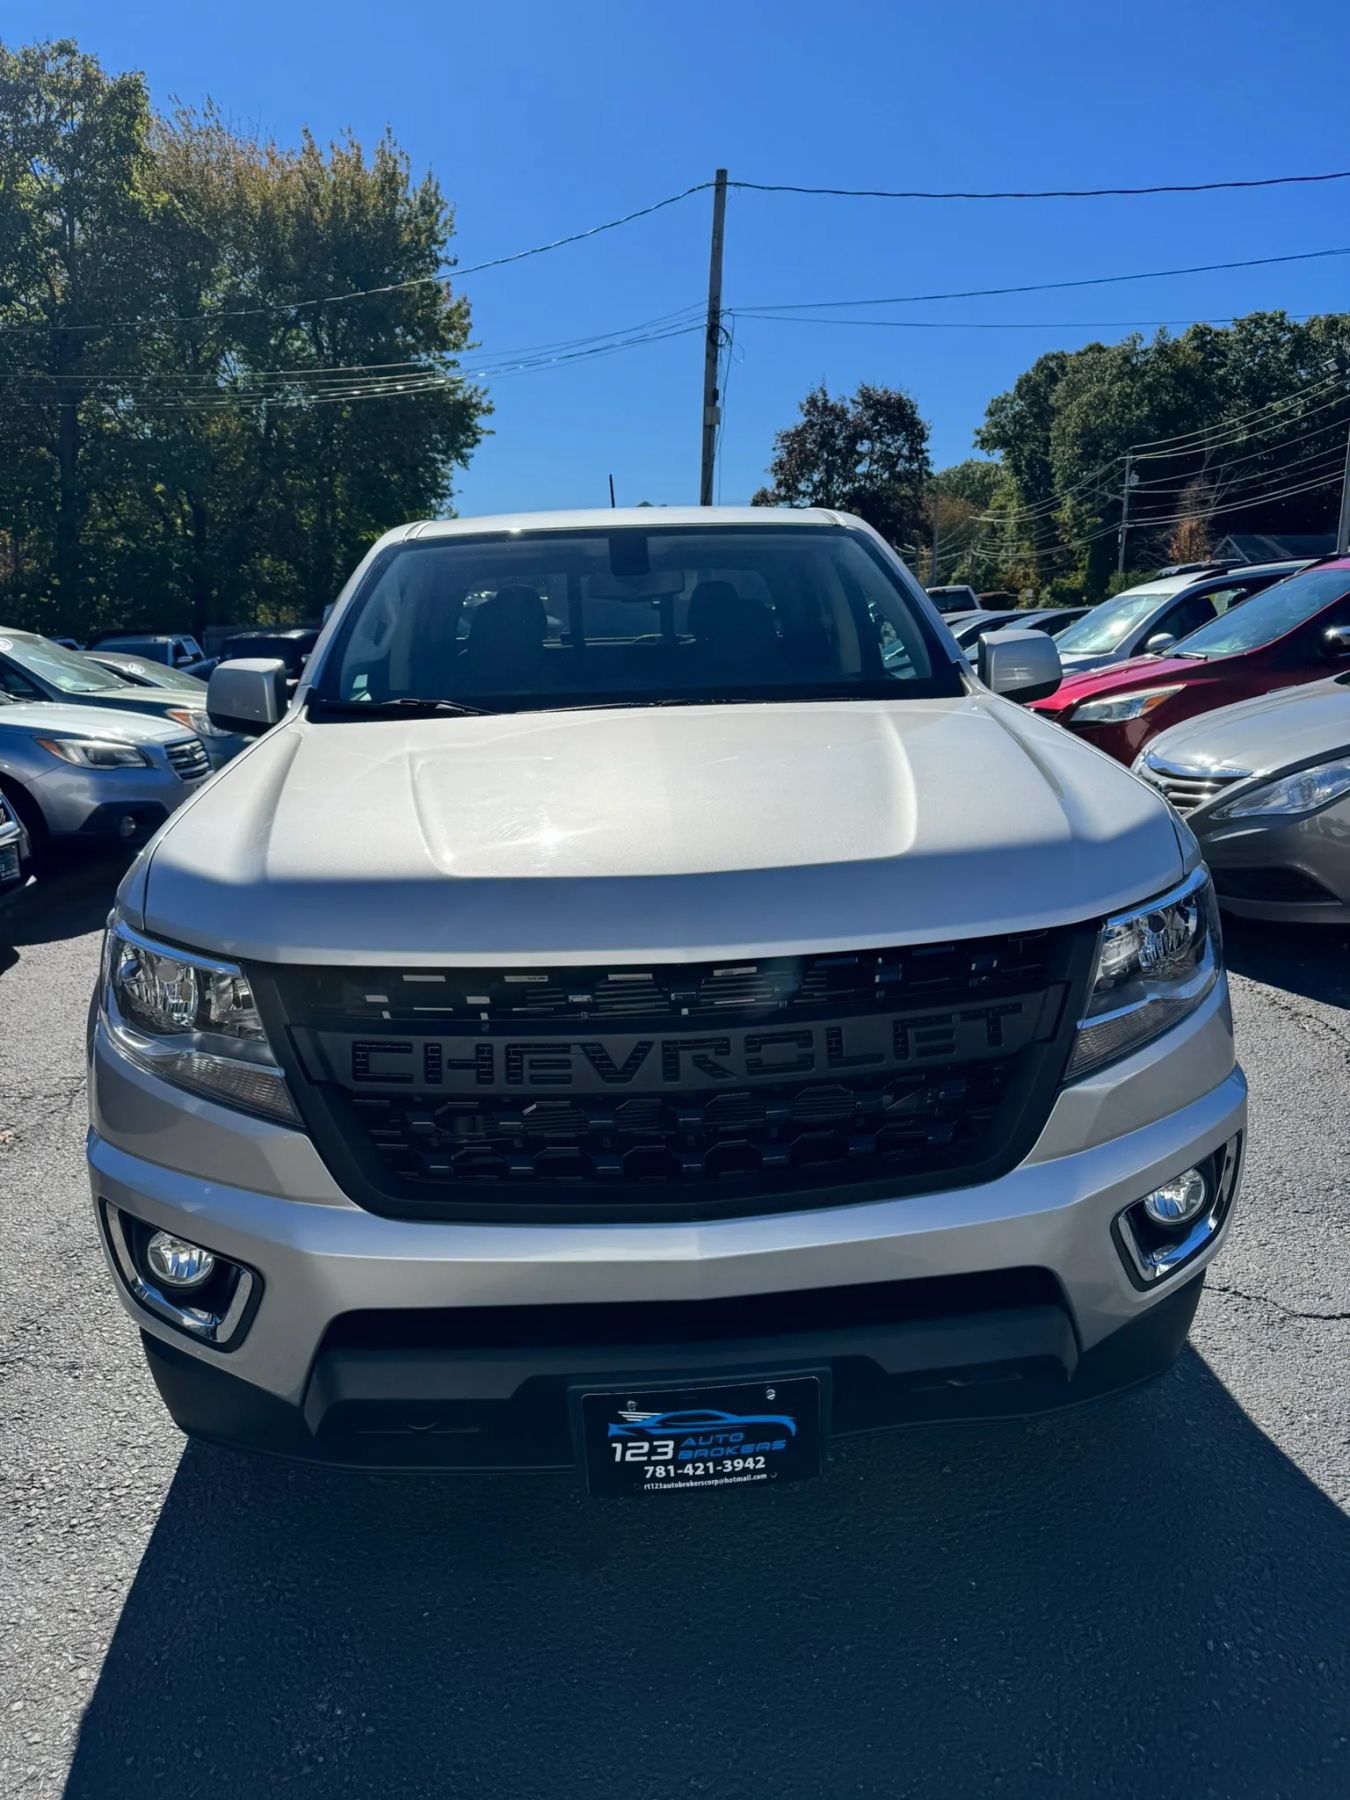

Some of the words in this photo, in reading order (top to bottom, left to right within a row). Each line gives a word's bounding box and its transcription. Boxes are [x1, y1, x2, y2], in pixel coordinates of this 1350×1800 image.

[351, 1001, 1024, 1085] CHEVROLET
[678, 1439, 787, 1460] BROKERS
[680, 1432, 744, 1447] AUTO
[611, 1440, 674, 1462] 123
[644, 1456, 766, 1479] 781-421-3942
